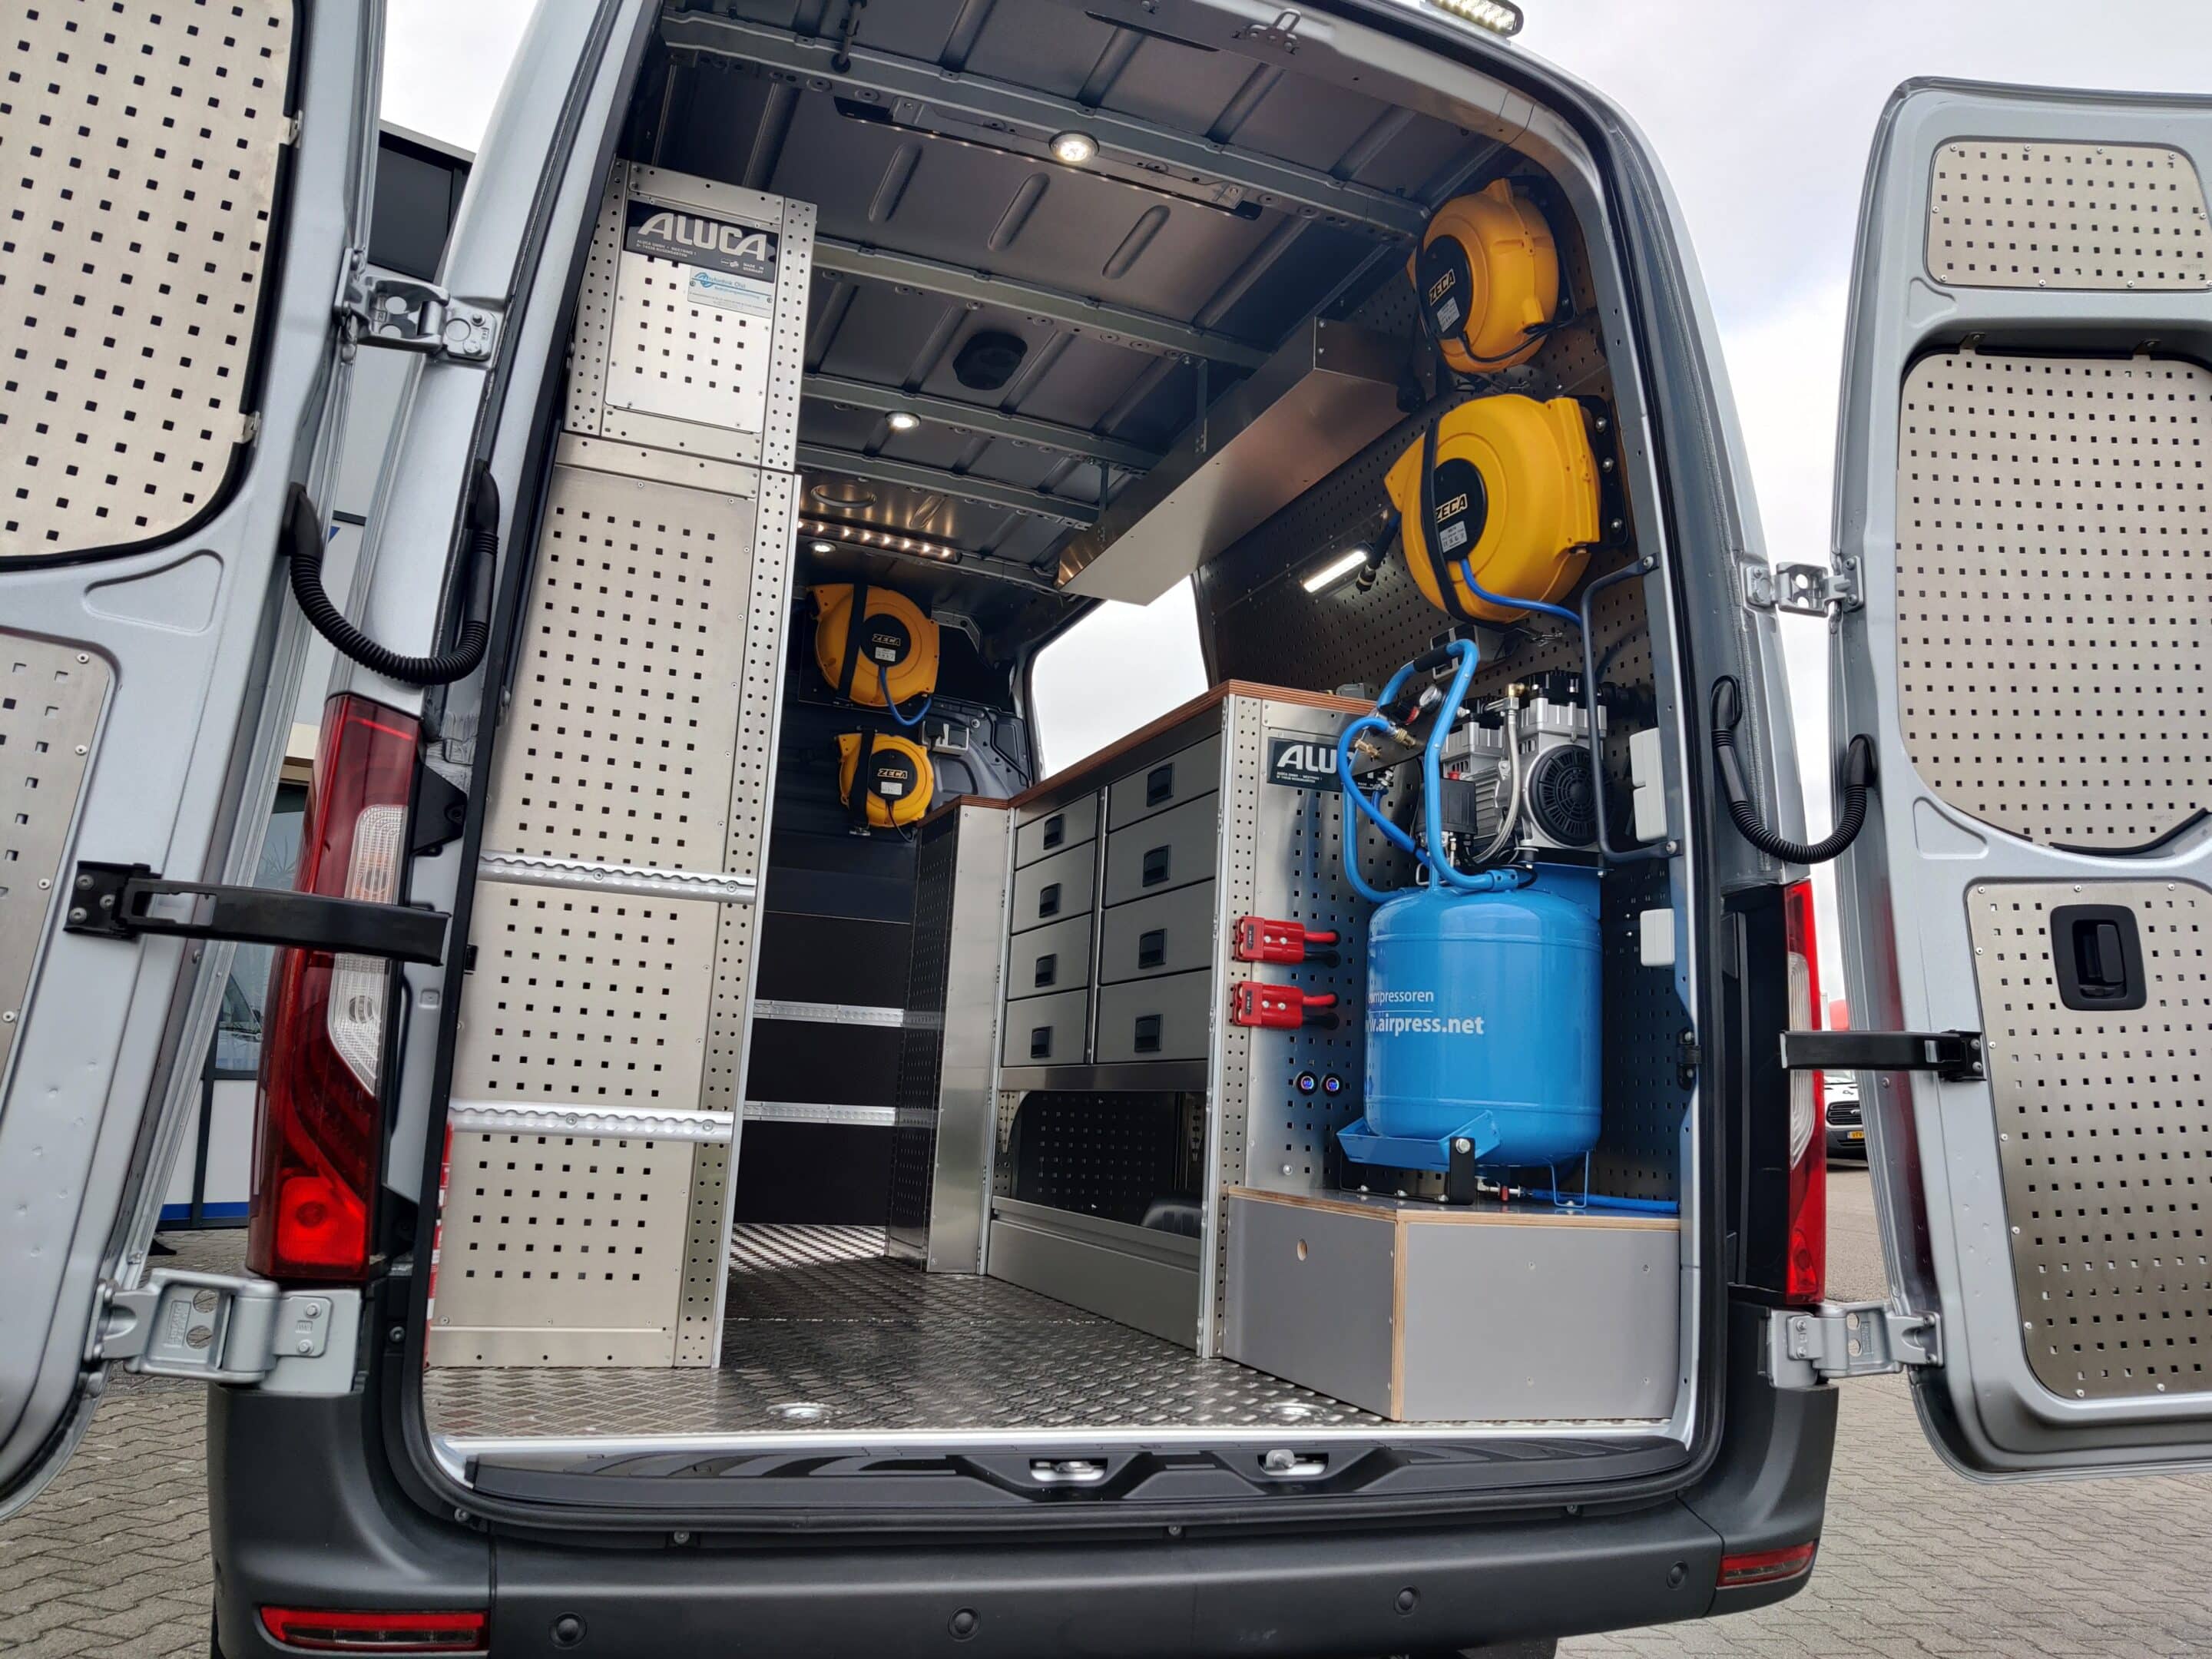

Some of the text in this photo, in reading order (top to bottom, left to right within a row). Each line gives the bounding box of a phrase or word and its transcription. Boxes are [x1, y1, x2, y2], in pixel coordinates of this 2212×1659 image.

[637, 212, 767, 262] ALUCA
[1429, 270, 1455, 305] ZECA
[1435, 494, 1467, 522] ZECA
[873, 634, 900, 646] ZECA
[878, 768, 907, 779] ZECA
[1277, 744, 1356, 775] ALU
[1368, 990, 1434, 1006] ompressoren
